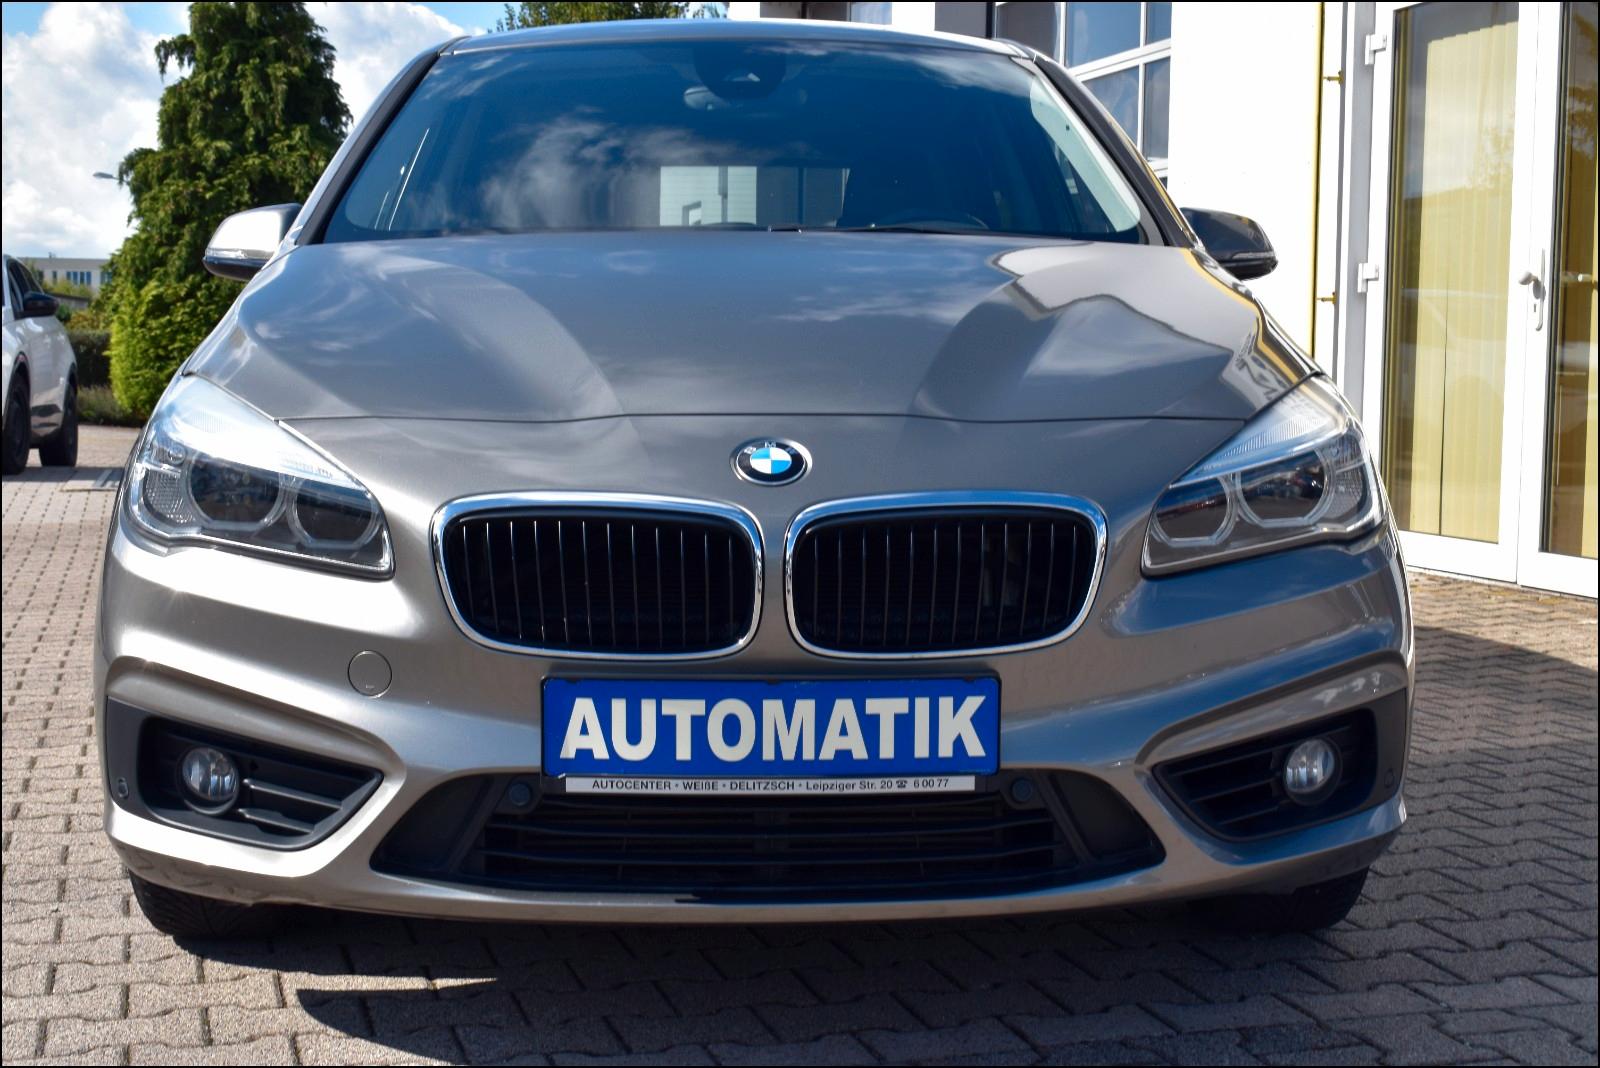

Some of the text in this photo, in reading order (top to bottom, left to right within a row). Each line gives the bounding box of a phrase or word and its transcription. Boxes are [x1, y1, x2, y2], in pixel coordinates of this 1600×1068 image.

[559, 695, 986, 762] AUTOMATIK
[592, 780, 671, 790] AUTOCENTER
[729, 780, 795, 791] DELITZSCH
[806, 780, 856, 792] Leipziger
[858, 779, 877, 790] Str.
[880, 779, 893, 790] 20
